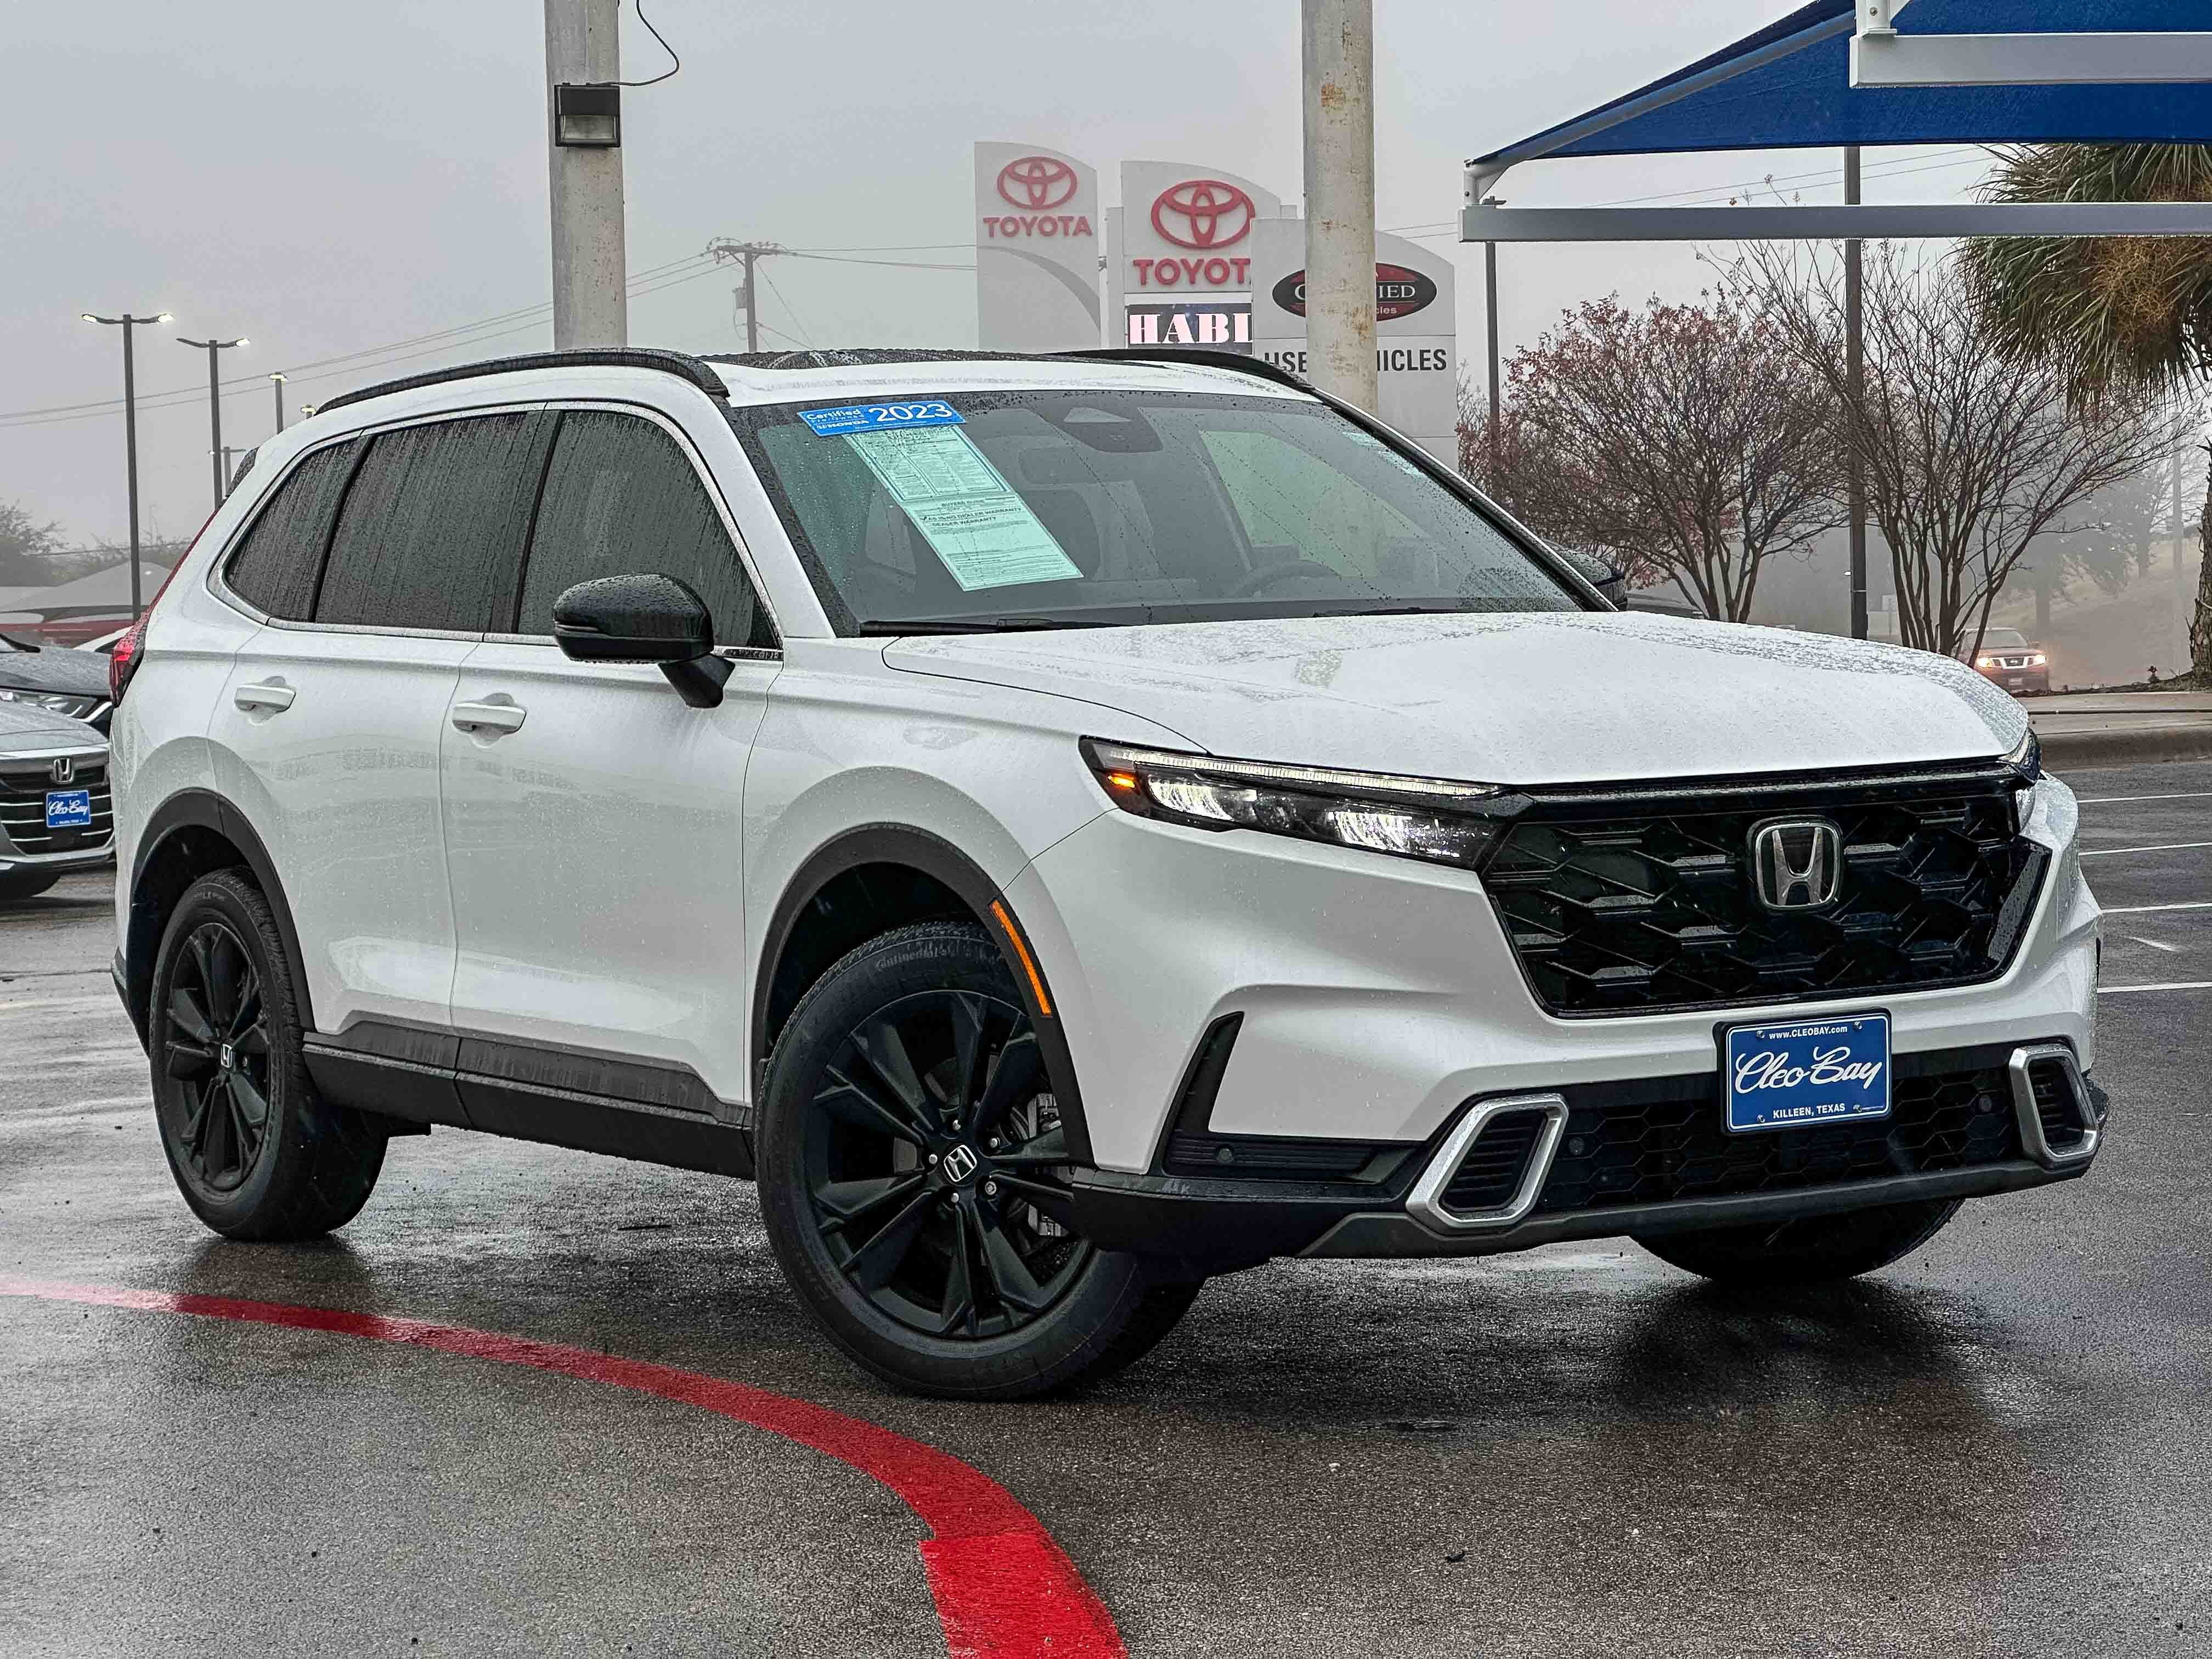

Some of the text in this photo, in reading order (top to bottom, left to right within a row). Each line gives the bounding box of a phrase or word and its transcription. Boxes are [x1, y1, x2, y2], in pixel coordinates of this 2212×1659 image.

[983, 215, 1093, 238] TOYOTA
[1132, 258, 1251, 285] TOYOT
[806, 403, 952, 422] Certified 2023
[1769, 1025, 1848, 1040] www.CLEOBAY.com
[1735, 1046, 1882, 1093] Cleo Bay
[1773, 1103, 1846, 1119] KILLEEN, TEXAS
